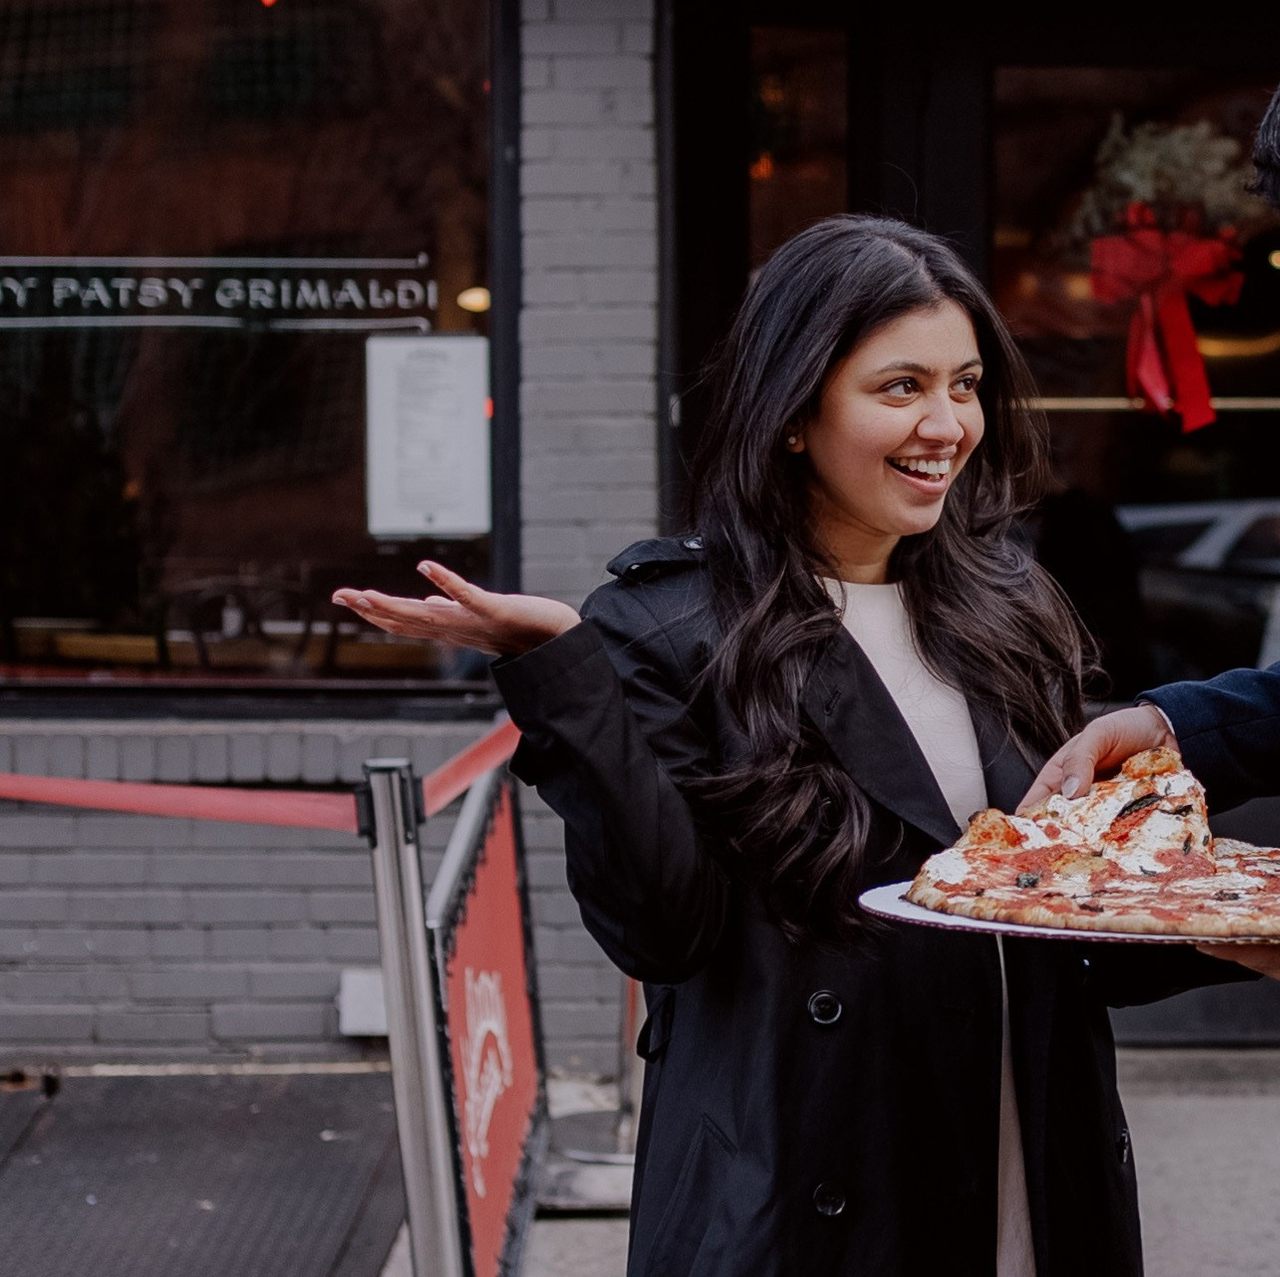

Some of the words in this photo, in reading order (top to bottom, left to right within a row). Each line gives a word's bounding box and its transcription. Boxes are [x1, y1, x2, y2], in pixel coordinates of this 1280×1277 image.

[0, 276, 38, 308] Y
[52, 277, 204, 308] PATSY
[215, 278, 439, 310] GRIMALDI
